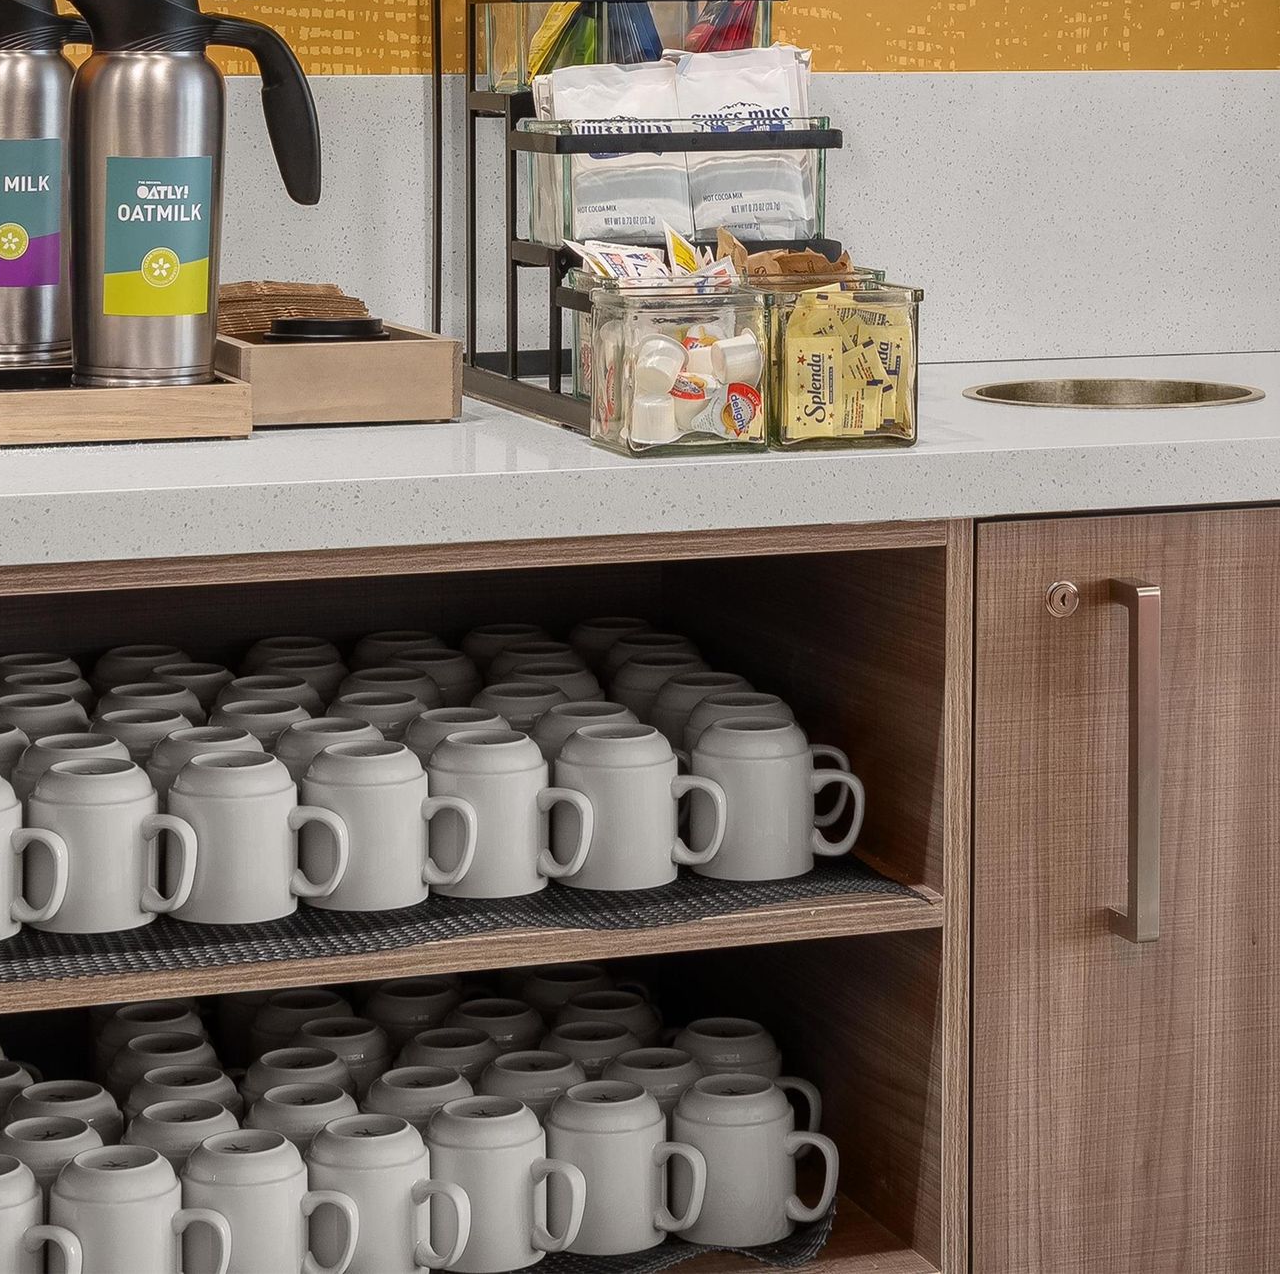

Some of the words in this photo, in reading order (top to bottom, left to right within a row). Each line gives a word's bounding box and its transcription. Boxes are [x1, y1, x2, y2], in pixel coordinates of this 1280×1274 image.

[4, 175, 50, 193] MILK
[136, 185, 189, 200] OATLY!
[702, 195, 713, 203] HOT
[714, 193, 732, 201] COCOA
[117, 204, 202, 222] OATMILK
[576, 205, 587, 214] HOT
[588, 205, 605, 213] COCOA
[606, 204, 617, 212] MIX
[730, 205, 740, 214] NET
[740, 204, 748, 213] WT
[604, 217, 613, 225] NET
[804, 353, 827, 424] Splenda
